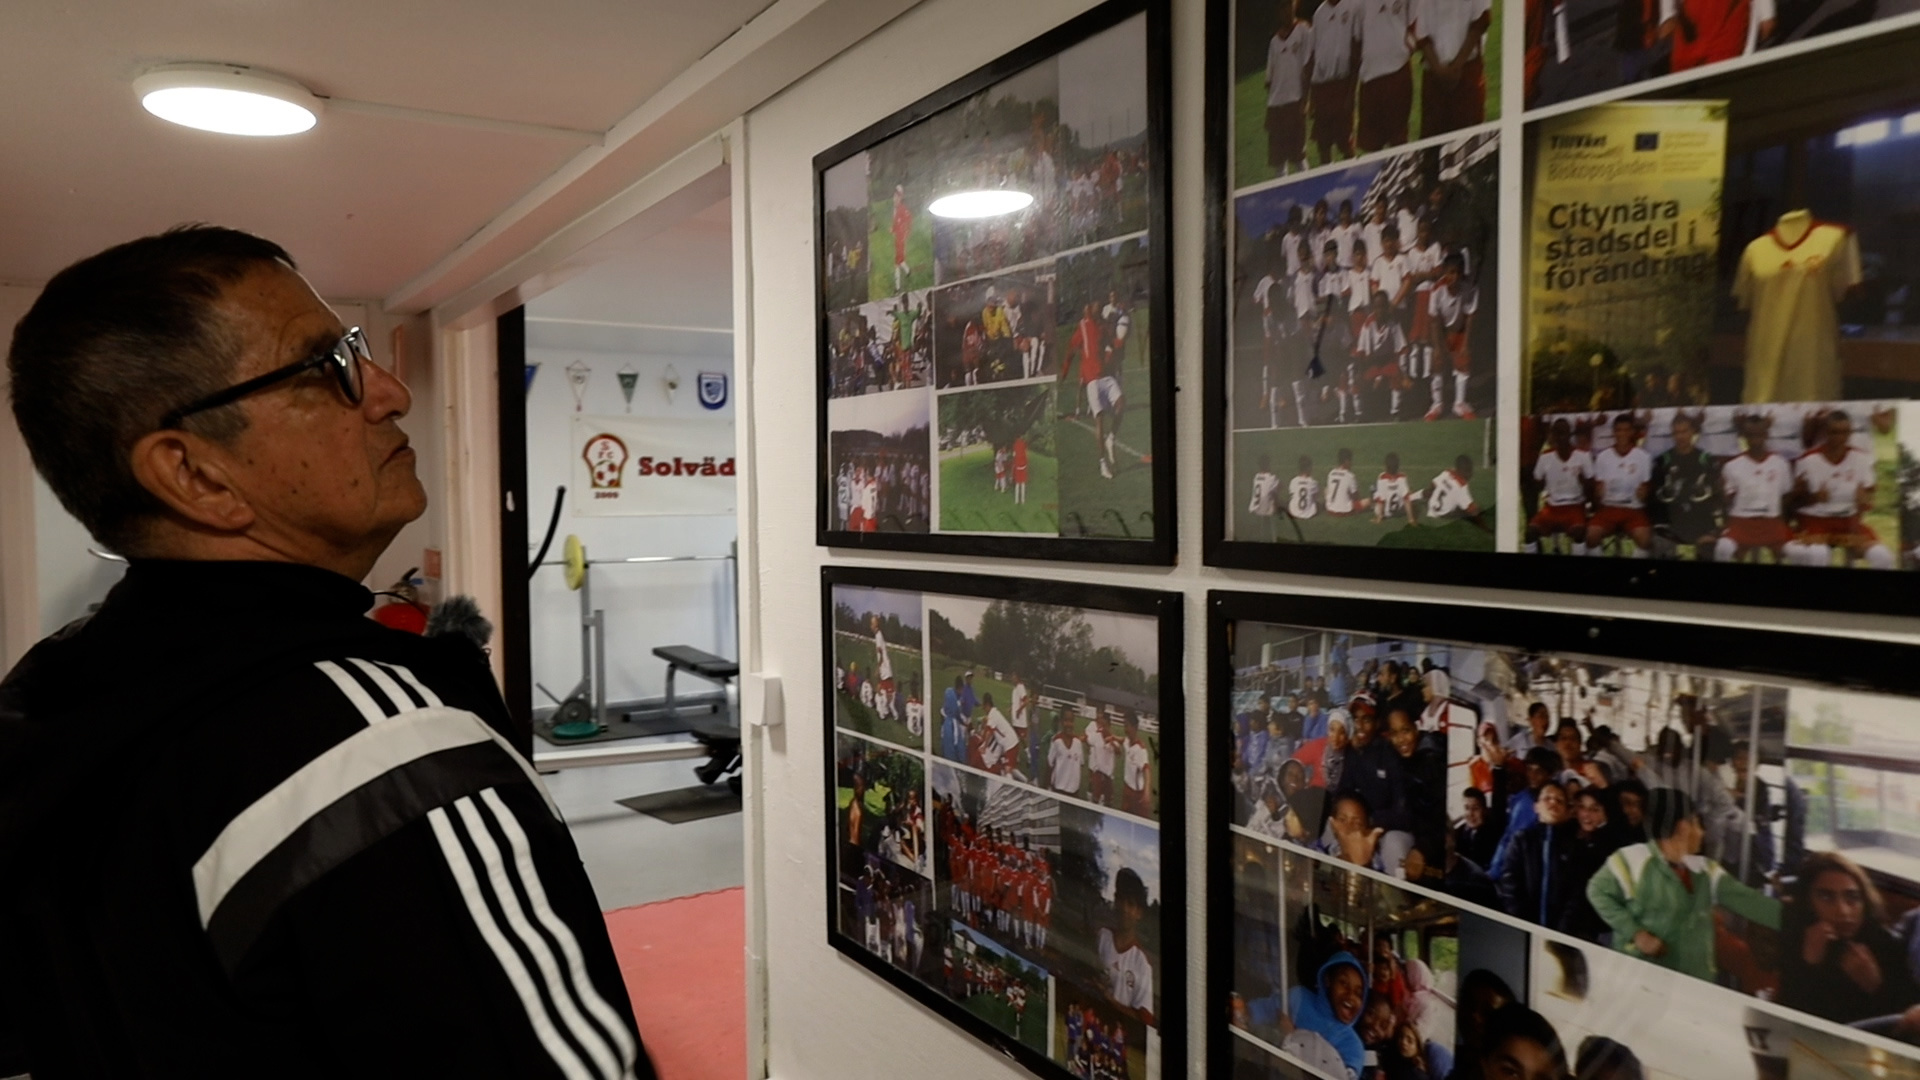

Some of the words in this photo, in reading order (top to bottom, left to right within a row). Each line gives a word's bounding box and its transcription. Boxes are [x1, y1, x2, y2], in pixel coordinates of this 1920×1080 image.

[1549, 196, 1679, 230] Citynära
[1546, 222, 1678, 262] stadsdel
[1688, 219, 1697, 245] i
[1544, 250, 1707, 291] förändring
[1298, 486, 1308, 510] 8
[1331, 479, 1341, 501] 7
